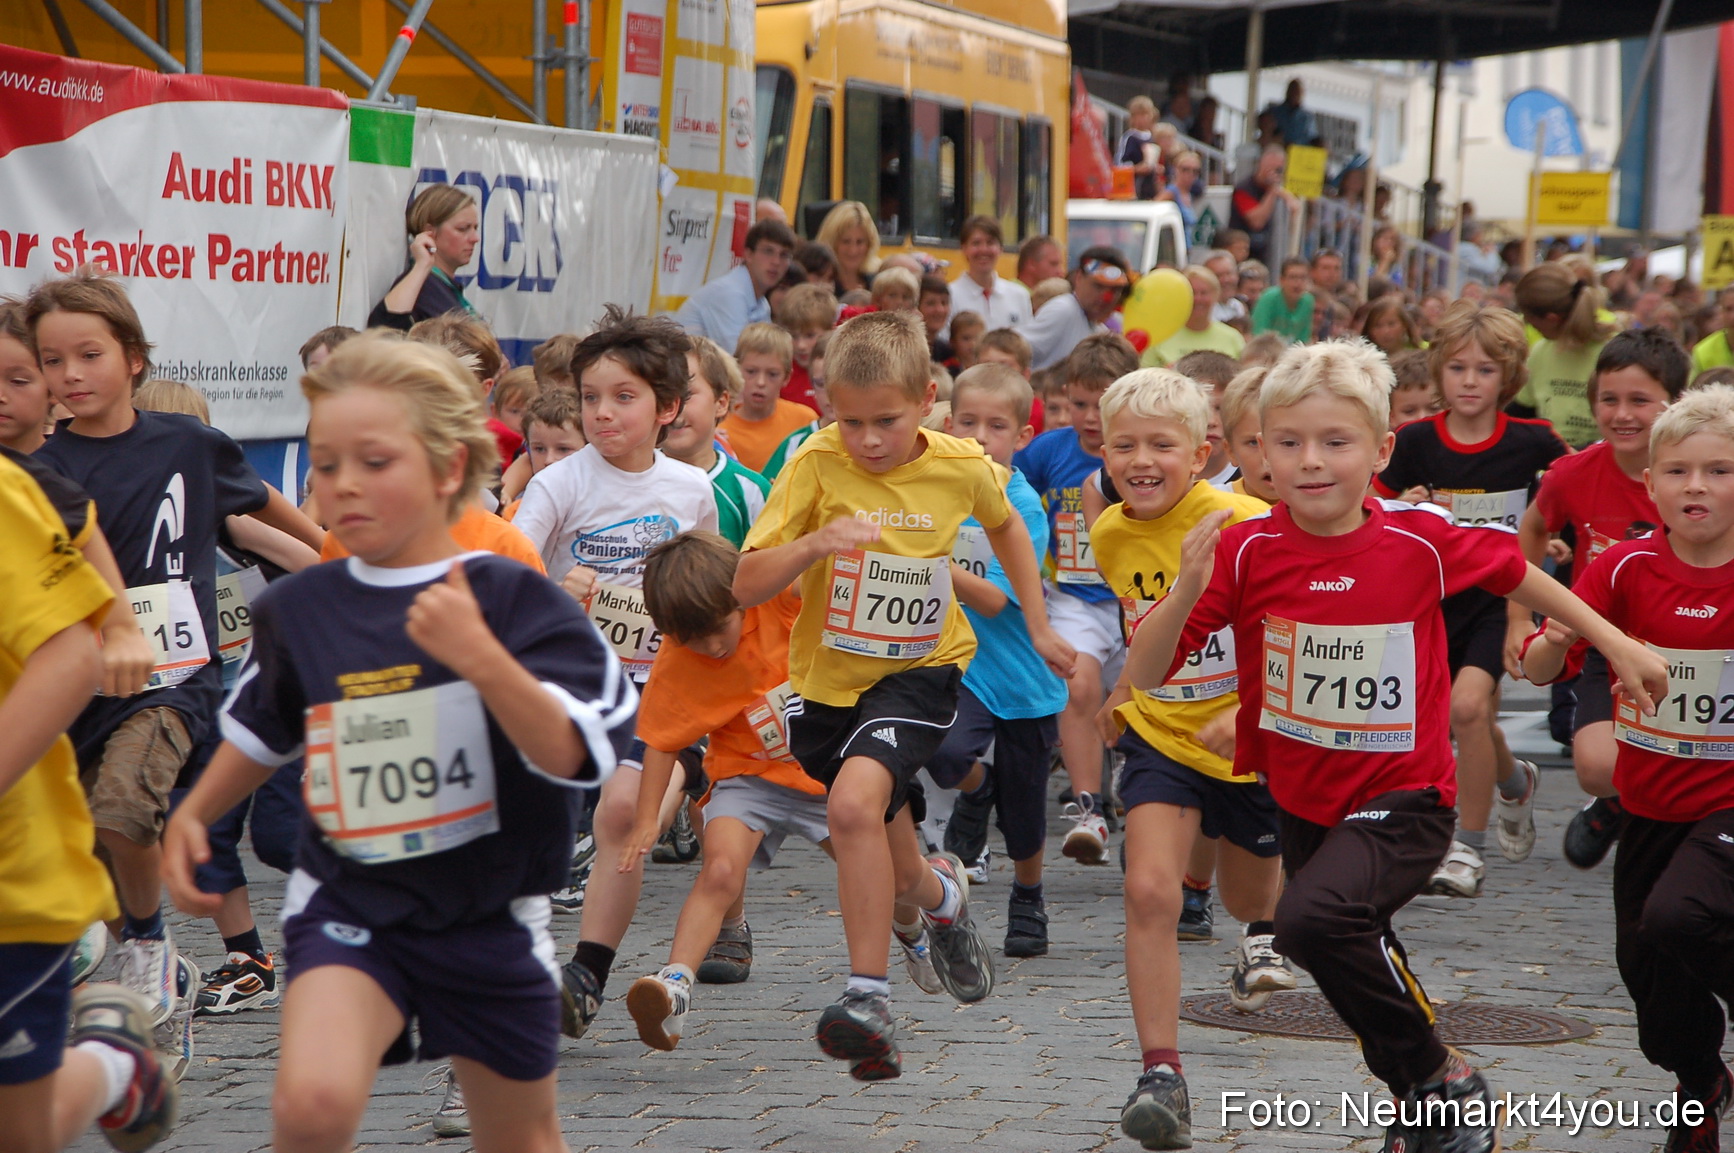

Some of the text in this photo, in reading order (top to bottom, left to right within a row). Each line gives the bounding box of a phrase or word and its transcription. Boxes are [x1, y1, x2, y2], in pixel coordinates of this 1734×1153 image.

[162, 152, 336, 217] Audi BKK,
[406, 167, 563, 293] OCK
[53, 229, 195, 278] starker
[207, 234, 330, 284] Partner.
[855, 507, 933, 528] adidas
[576, 530, 628, 544] Grundschule
[868, 560, 933, 586] Dominik
[834, 585, 850, 601] K4
[1309, 581, 1345, 592] JAKO
[867, 593, 941, 625] 7002
[1675, 606, 1708, 619] JAKO
[141, 621, 193, 652] 15
[595, 617, 662, 654] 7015
[1302, 635, 1364, 661] André
[1268, 660, 1284, 680] K4
[1668, 661, 1696, 680] vin
[1303, 672, 1402, 711] 7193
[1276, 719, 1314, 736] BOCK
[1353, 731, 1412, 743] PFLEIDERER
[349, 748, 476, 809] 7094
